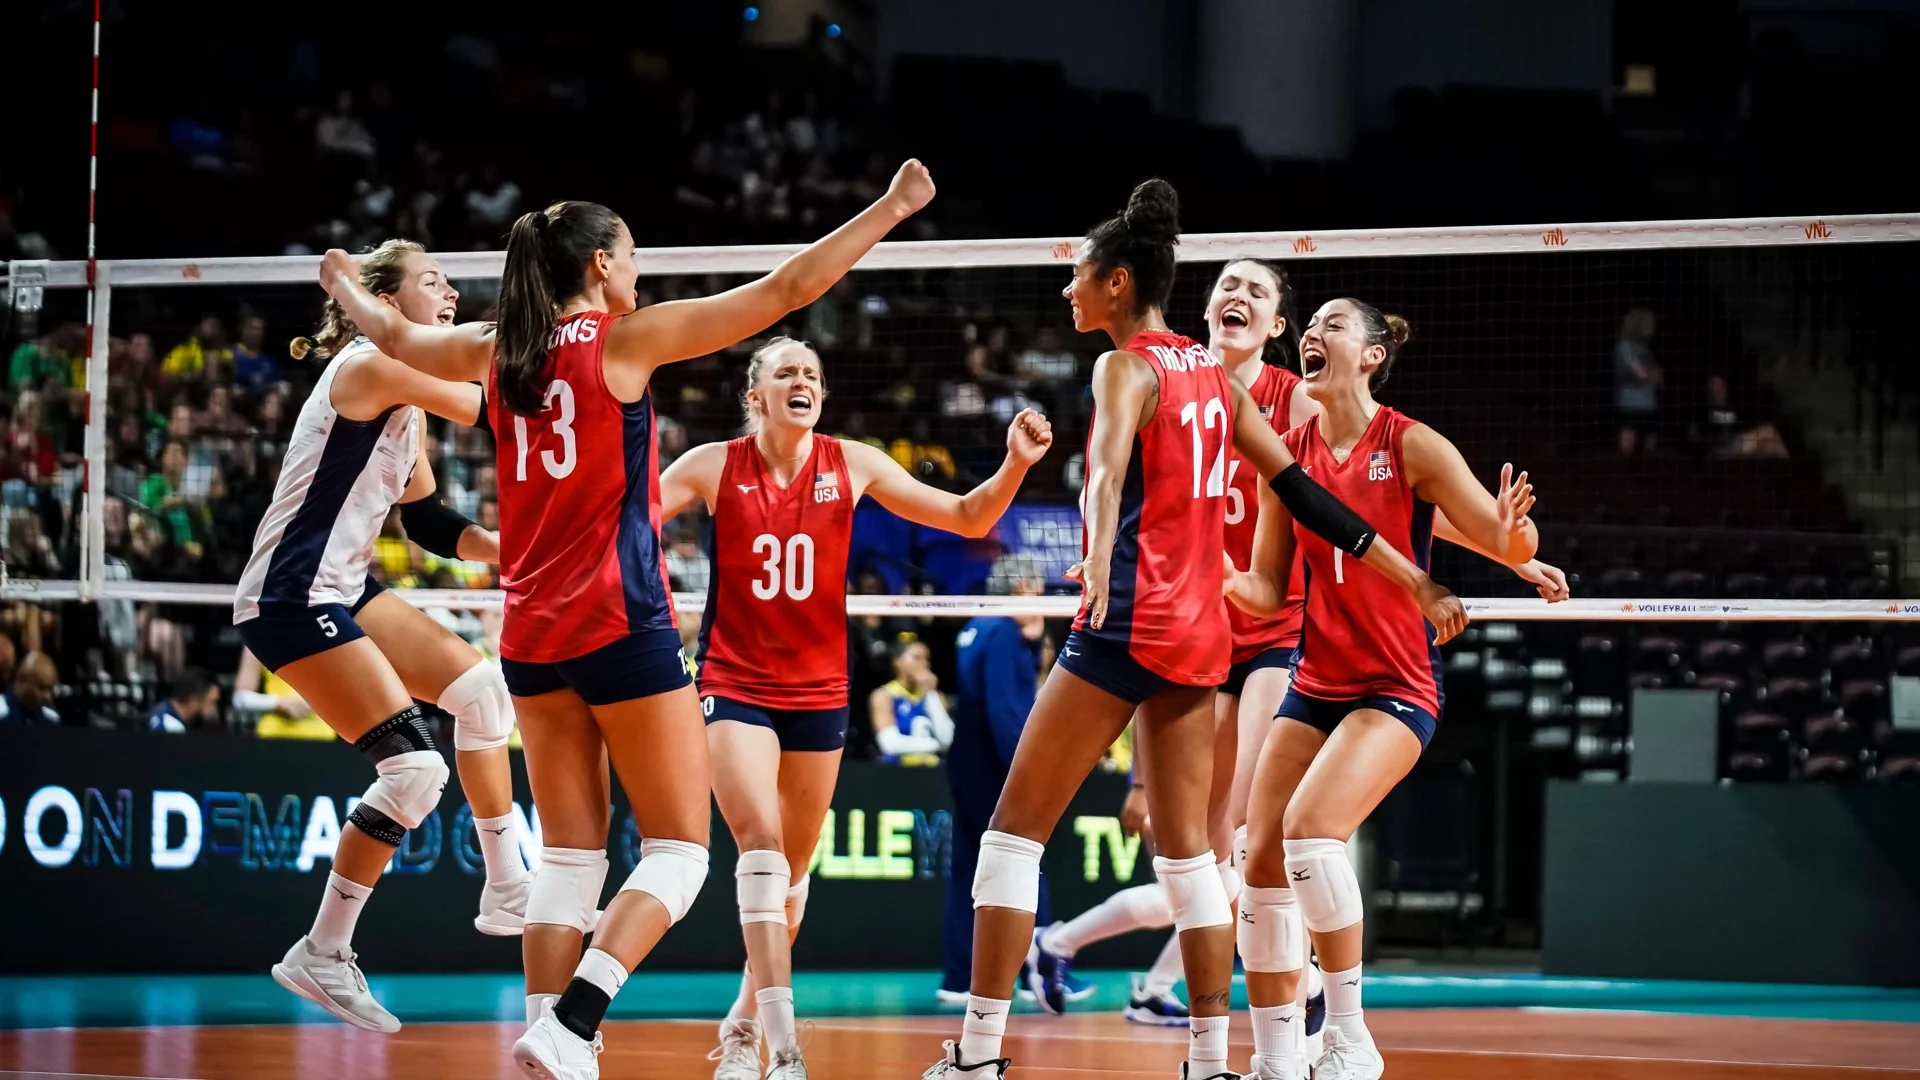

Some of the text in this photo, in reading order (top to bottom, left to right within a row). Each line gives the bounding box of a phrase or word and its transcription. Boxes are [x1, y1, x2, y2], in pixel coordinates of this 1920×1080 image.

[1543, 228, 1568, 246] VNL
[514, 379, 577, 481] 13
[1181, 397, 1227, 499] 12
[815, 487, 840, 503] USA
[1369, 465, 1393, 481] USA
[752, 533, 814, 600] 30
[316, 613, 338, 637] 5
[1639, 604, 1696, 612] VOLLEYBALL
[24, 785, 133, 868] ON
[1073, 816, 1141, 882] TV
